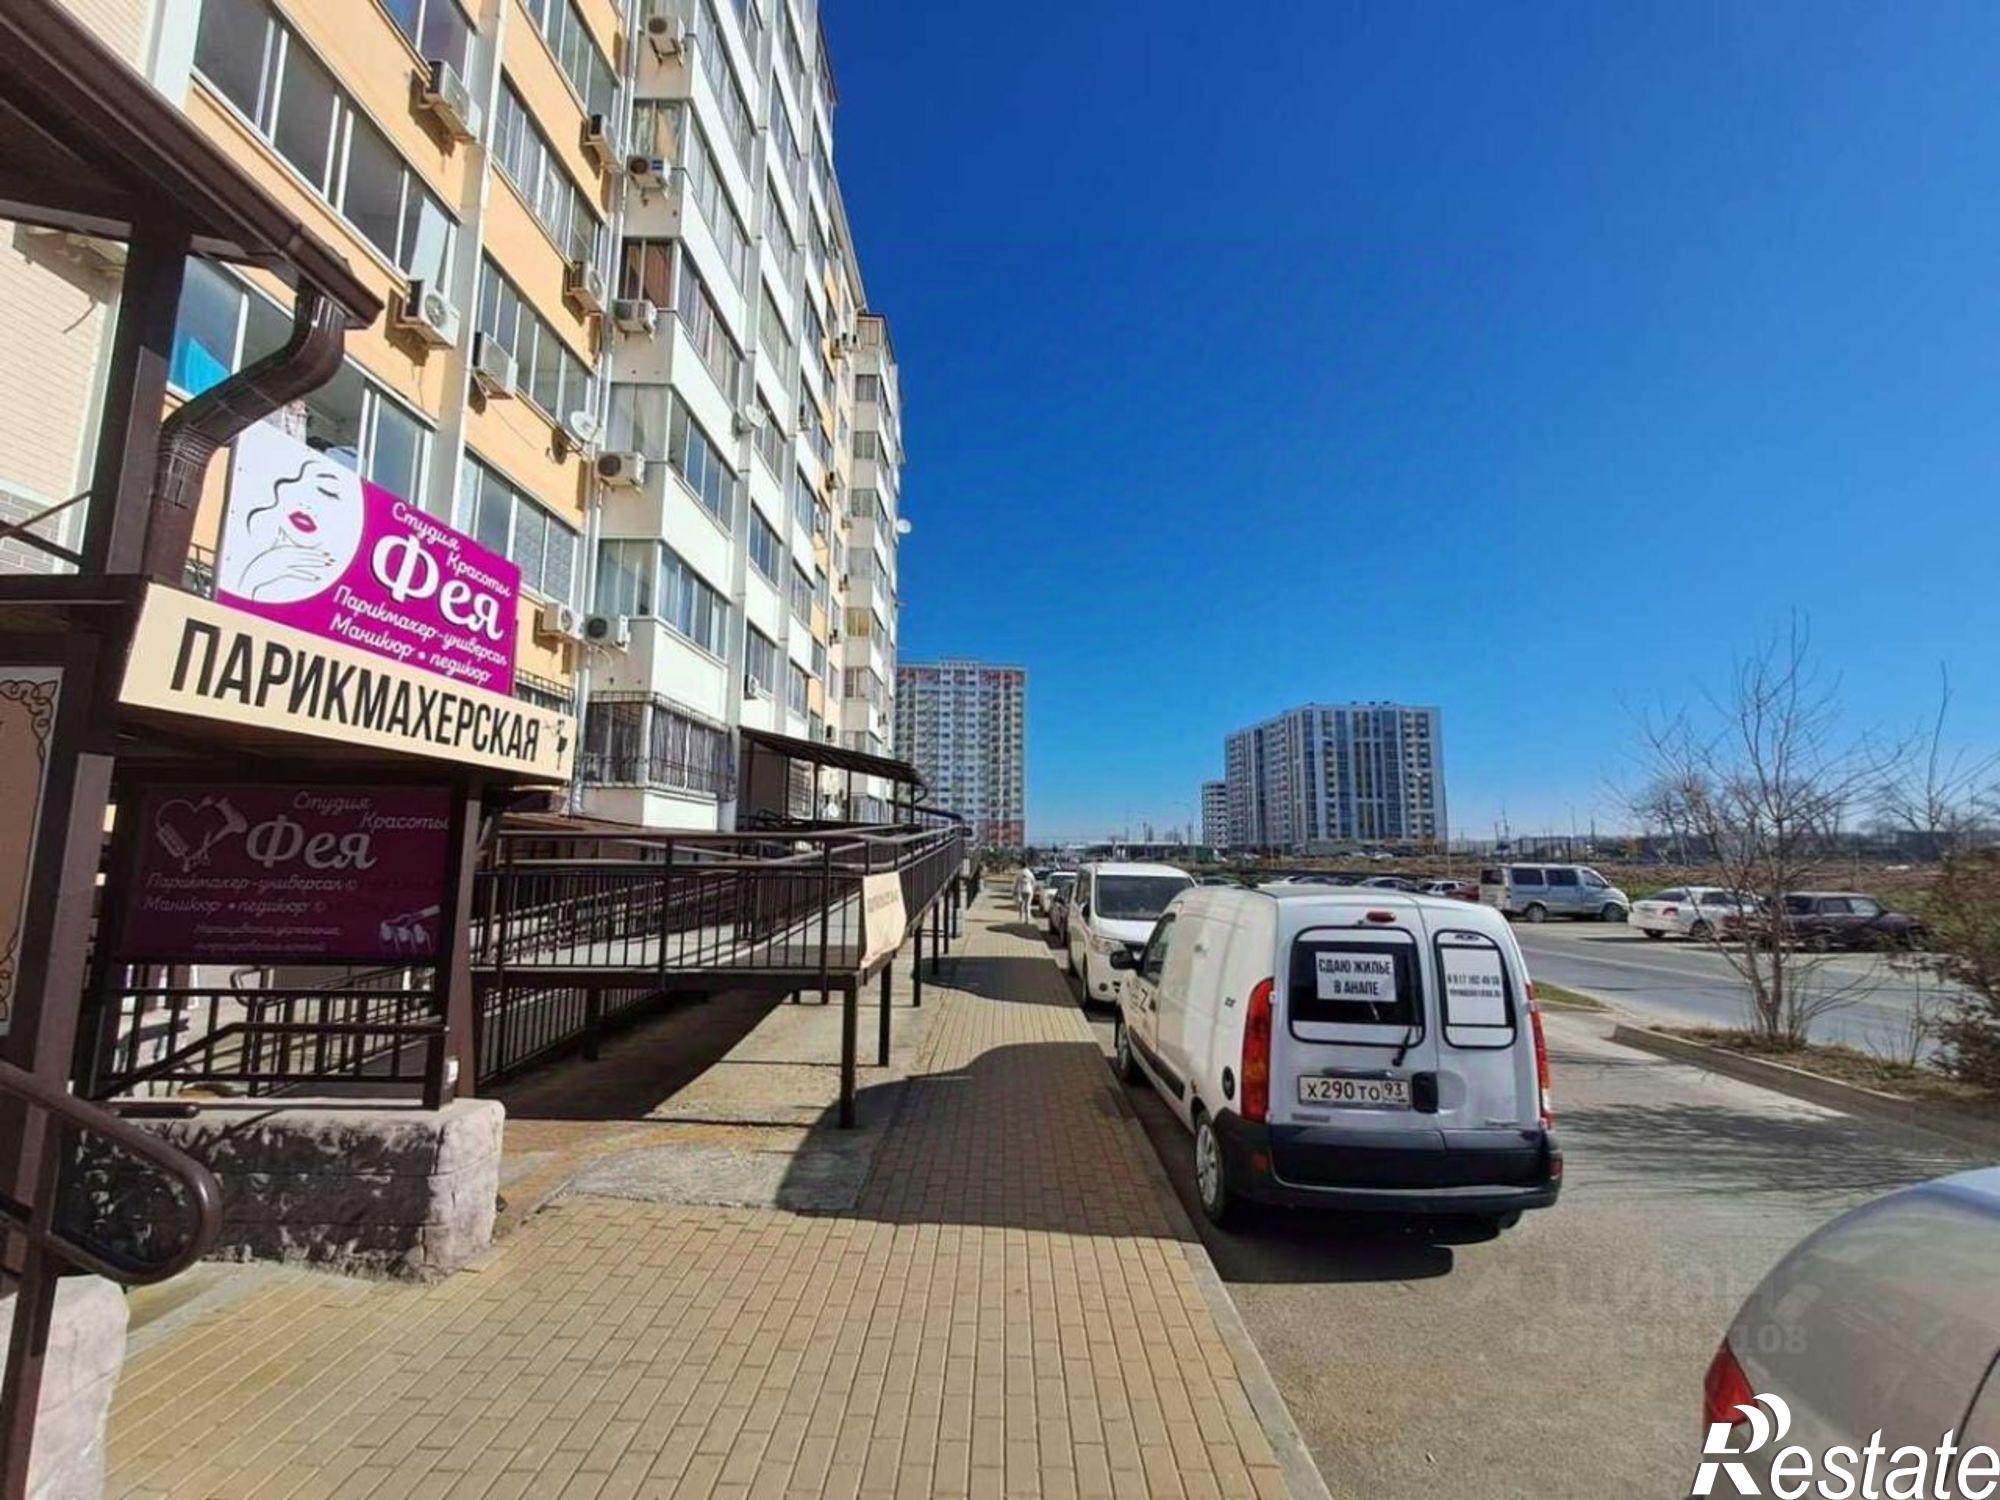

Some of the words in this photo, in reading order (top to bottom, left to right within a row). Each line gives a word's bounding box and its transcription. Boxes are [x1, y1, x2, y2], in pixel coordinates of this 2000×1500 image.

[392, 501, 460, 552] Студия
[372, 533, 504, 641] Фея
[446, 551, 512, 598] Красоты
[329, 613, 415, 660] Маникюр
[429, 652, 493, 685] педикюр
[170, 617, 540, 763] ПАРИКМАХЕРСКАЯ
[245, 813, 378, 870] Фея
[361, 812, 450, 835] Красоты
[1319, 959, 1351, 974] СДАЮ
[1333, 979, 1341, 994] В
[1344, 980, 1379, 995] АНАПЕ
